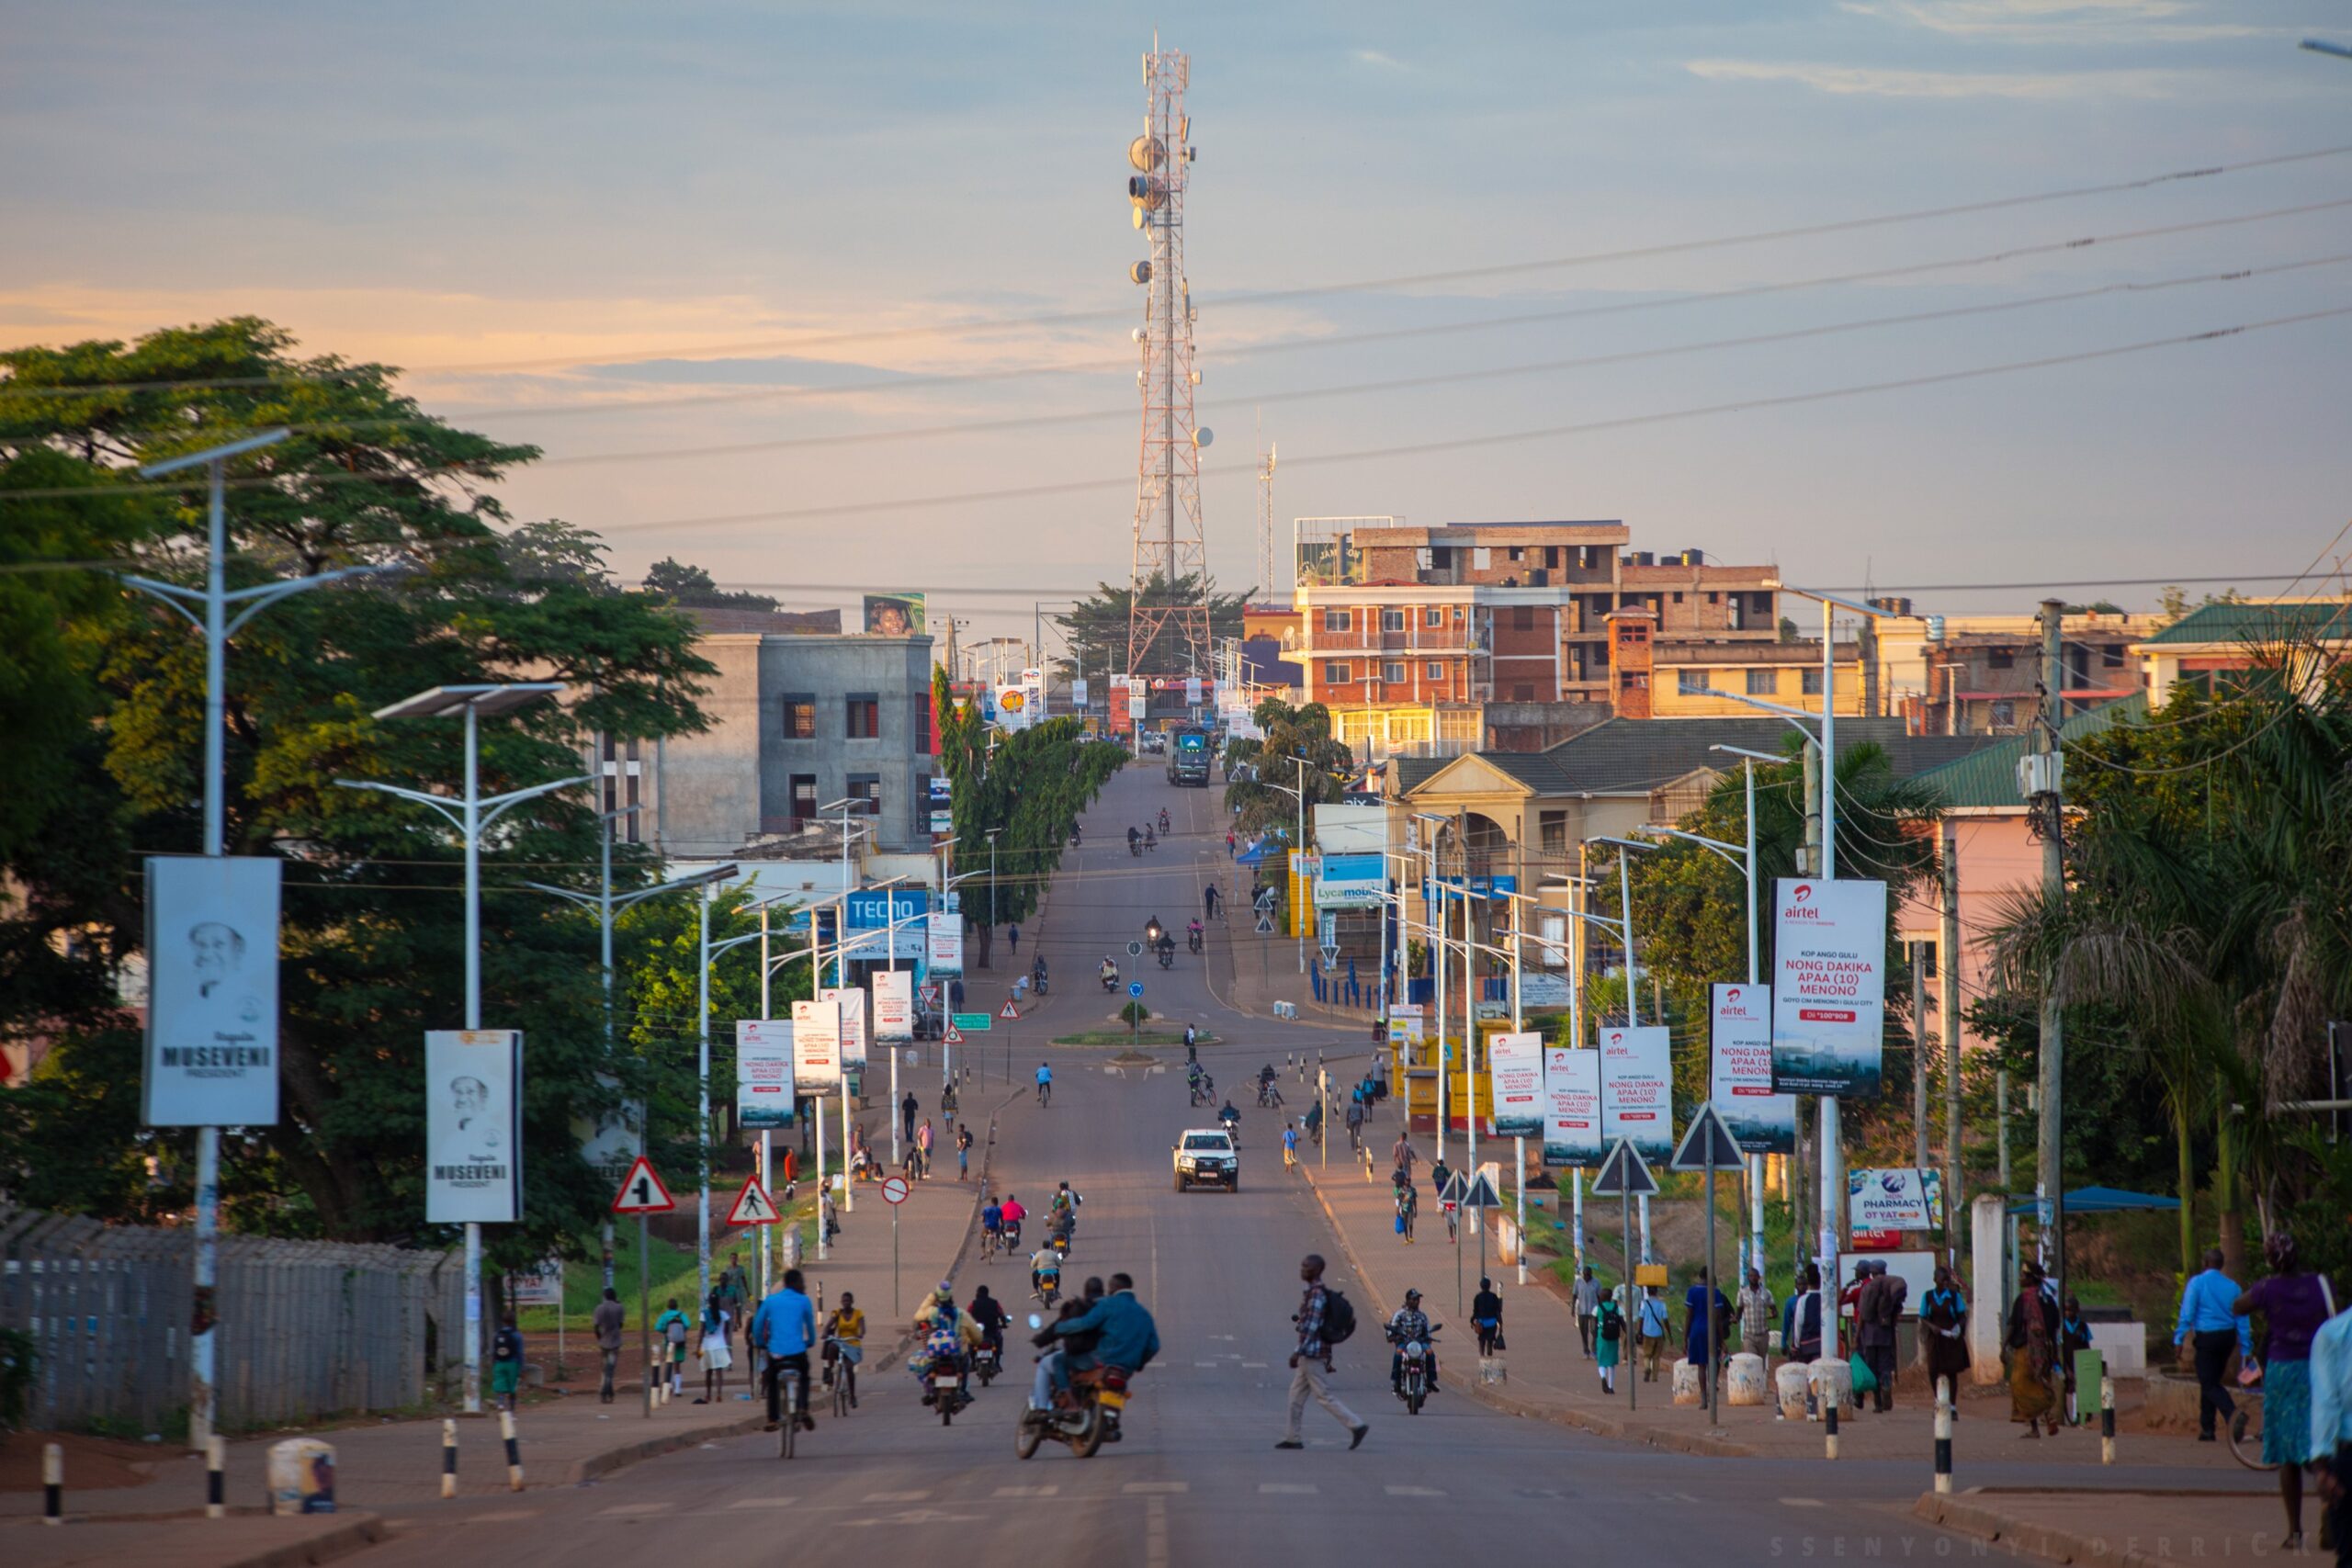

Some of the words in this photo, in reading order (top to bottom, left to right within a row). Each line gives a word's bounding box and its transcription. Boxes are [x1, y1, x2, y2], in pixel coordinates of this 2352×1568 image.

[1319, 548, 1361, 559] JAMON
[852, 900, 913, 918] TECNO
[1785, 906, 1819, 919] airtel
[1786, 960, 1823, 971] NONG
[1826, 961, 1872, 973] DAKIKA
[1798, 973, 1830, 983] APAA
[1834, 973, 1859, 985] (10)
[1800, 984, 1857, 996] MENONO
[1721, 1005, 1747, 1015] airtel
[162, 1047, 269, 1066] MUSEVENI
[1606, 1047, 1628, 1055] airtel
[1721, 1048, 1750, 1056] NONG
[1758, 1058, 1772, 1066] (1
[186, 1068, 246, 1078] PRESIDENT
[435, 1165, 506, 1180] MUSEVENI
[1864, 1199, 1922, 1208] PHARMACY
